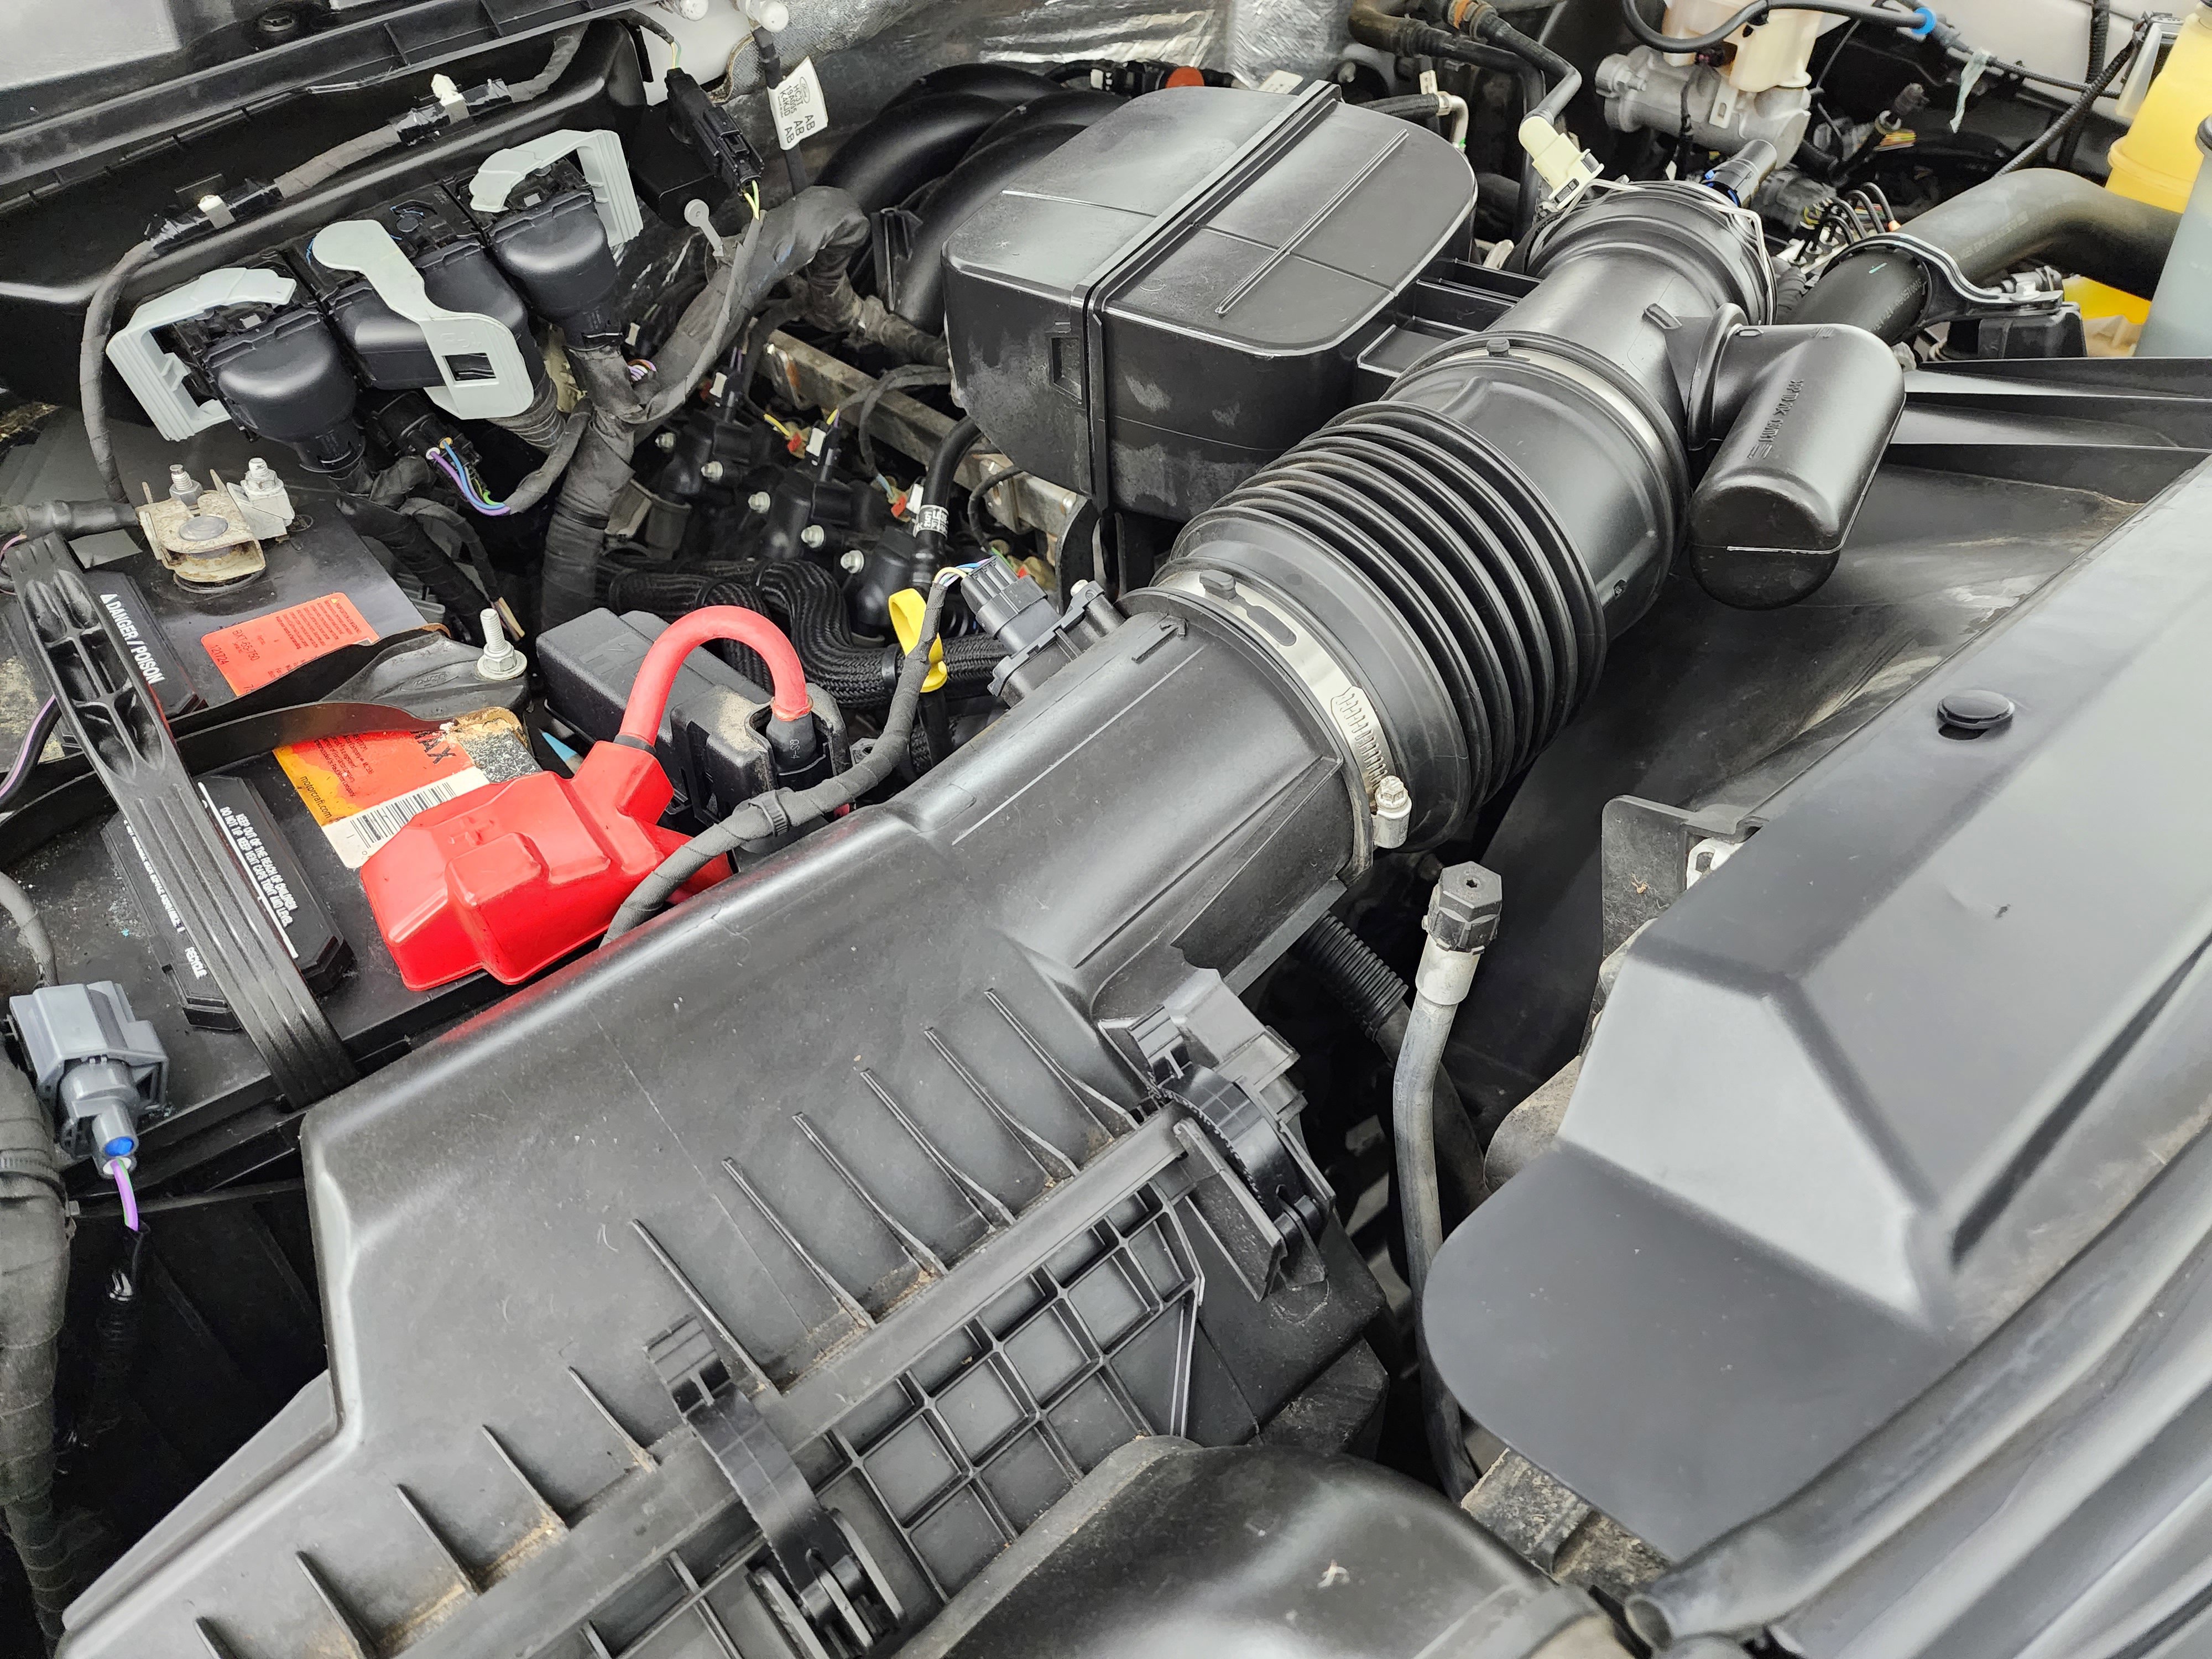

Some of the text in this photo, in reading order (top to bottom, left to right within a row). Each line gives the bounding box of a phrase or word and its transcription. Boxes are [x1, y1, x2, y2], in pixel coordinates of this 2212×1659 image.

[793, 84, 816, 131] HC3T AB
[784, 126, 795, 144] AB
[794, 121, 805, 136] AB
[106, 601, 139, 641] DANGER
[131, 646, 165, 685] POISON
[210, 645, 229, 665] 121724
[232, 629, 260, 661] BXT-65-750
[300, 776, 332, 818] motorcraft.com
[184, 946, 208, 979] RECYCLE
